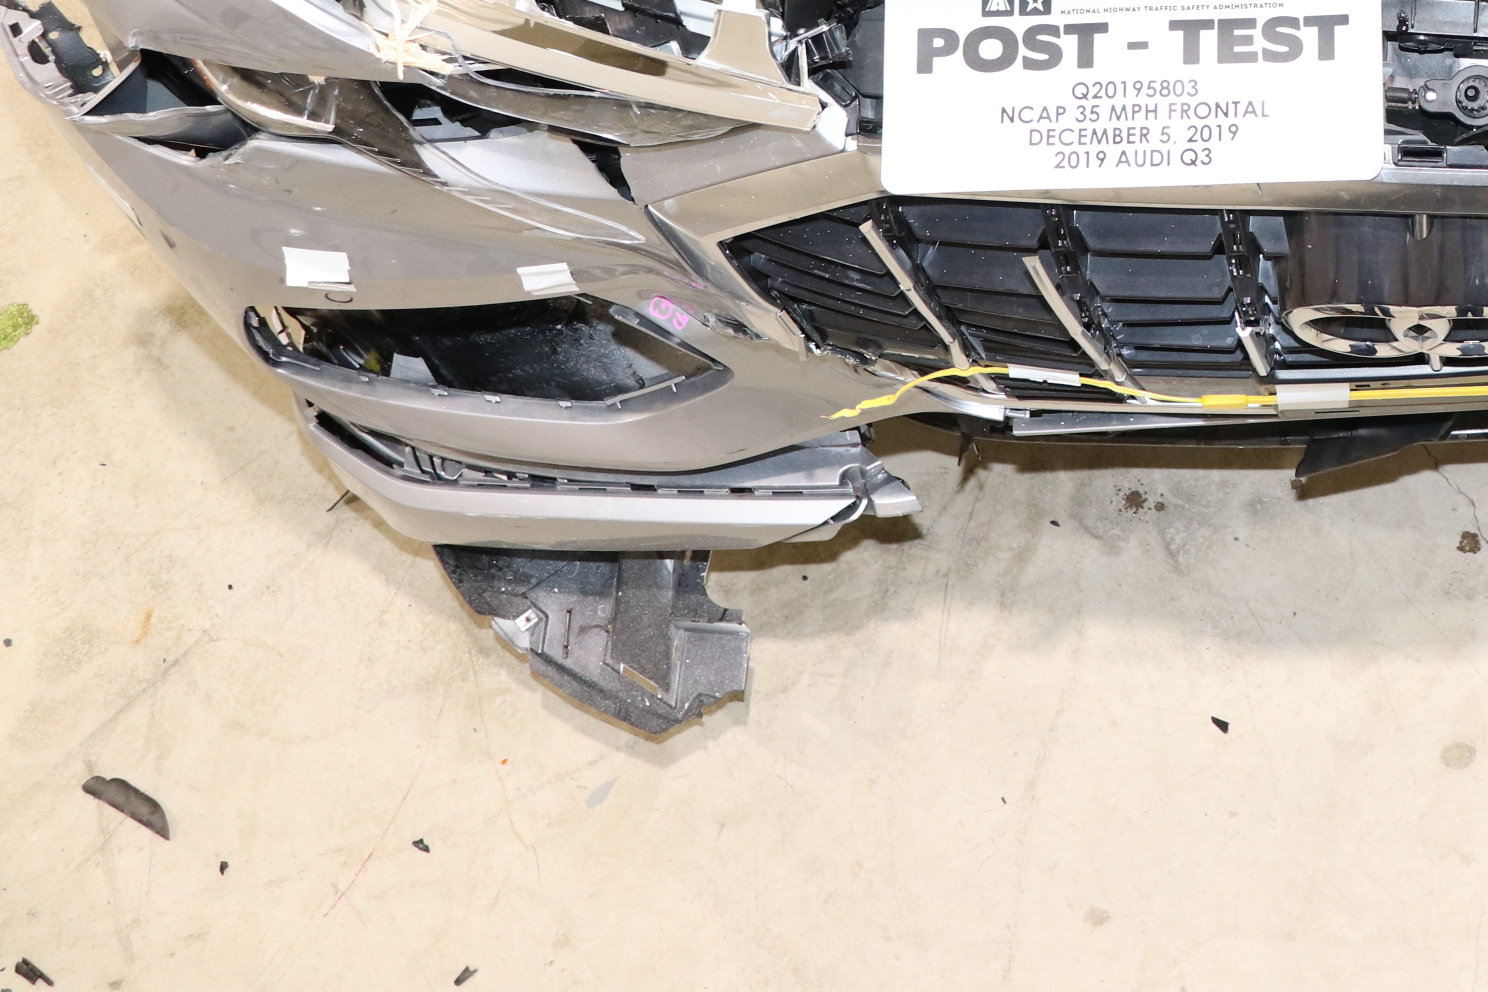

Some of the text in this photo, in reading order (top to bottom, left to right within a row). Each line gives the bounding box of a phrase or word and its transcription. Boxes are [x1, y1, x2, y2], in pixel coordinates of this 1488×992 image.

[1060, 7, 1101, 15] NATIONAL
[1213, 2, 1284, 10] ADMINISTRATION
[917, 14, 1350, 74] POST - TEST
[1071, 80, 1199, 100] Q20195803
[1000, 101, 1270, 124] NCAP 35 MPH FRONTAL
[1029, 124, 1239, 146] DECEMBER 5, 2019
[1054, 148, 1213, 169] 2019 AUDI Q3
